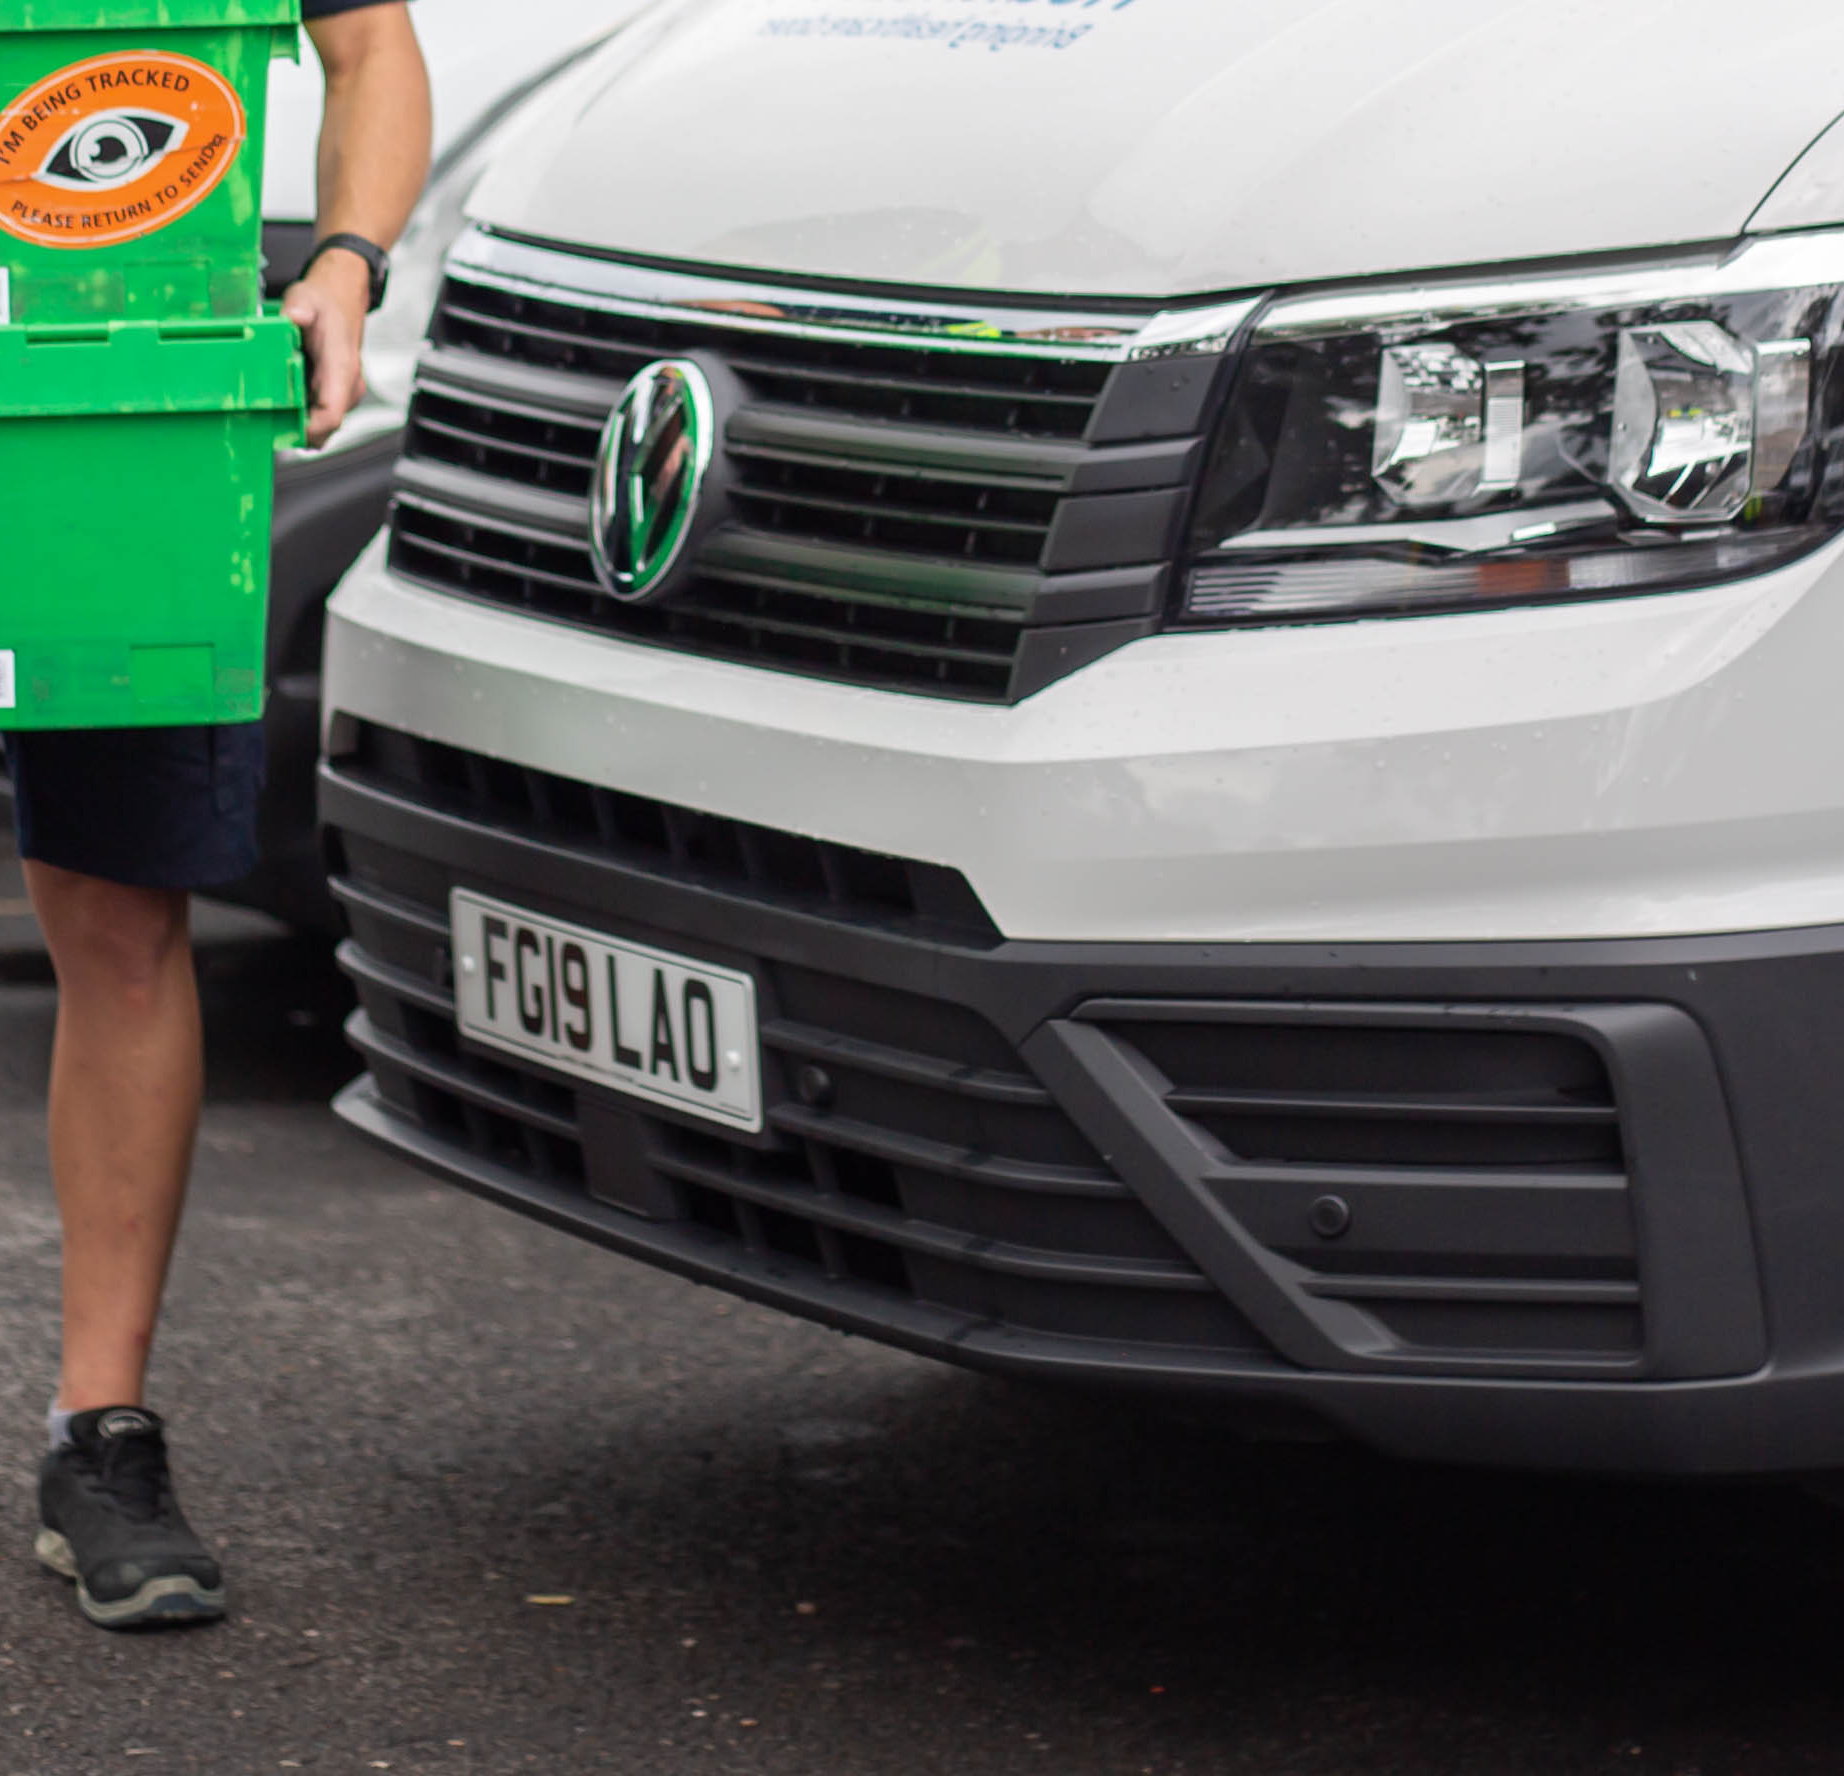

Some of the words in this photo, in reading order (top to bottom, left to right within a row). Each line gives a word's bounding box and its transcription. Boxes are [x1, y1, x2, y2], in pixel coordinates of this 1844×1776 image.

[21, 83, 82, 132] BEING
[85, 68, 190, 93] TRACKED
[11, 199, 74, 229] PLEASE
[82, 201, 152, 229] RETURN
[155, 185, 178, 206] TO
[482, 915, 593, 1052] FG19
[606, 954, 718, 1093] LAO
